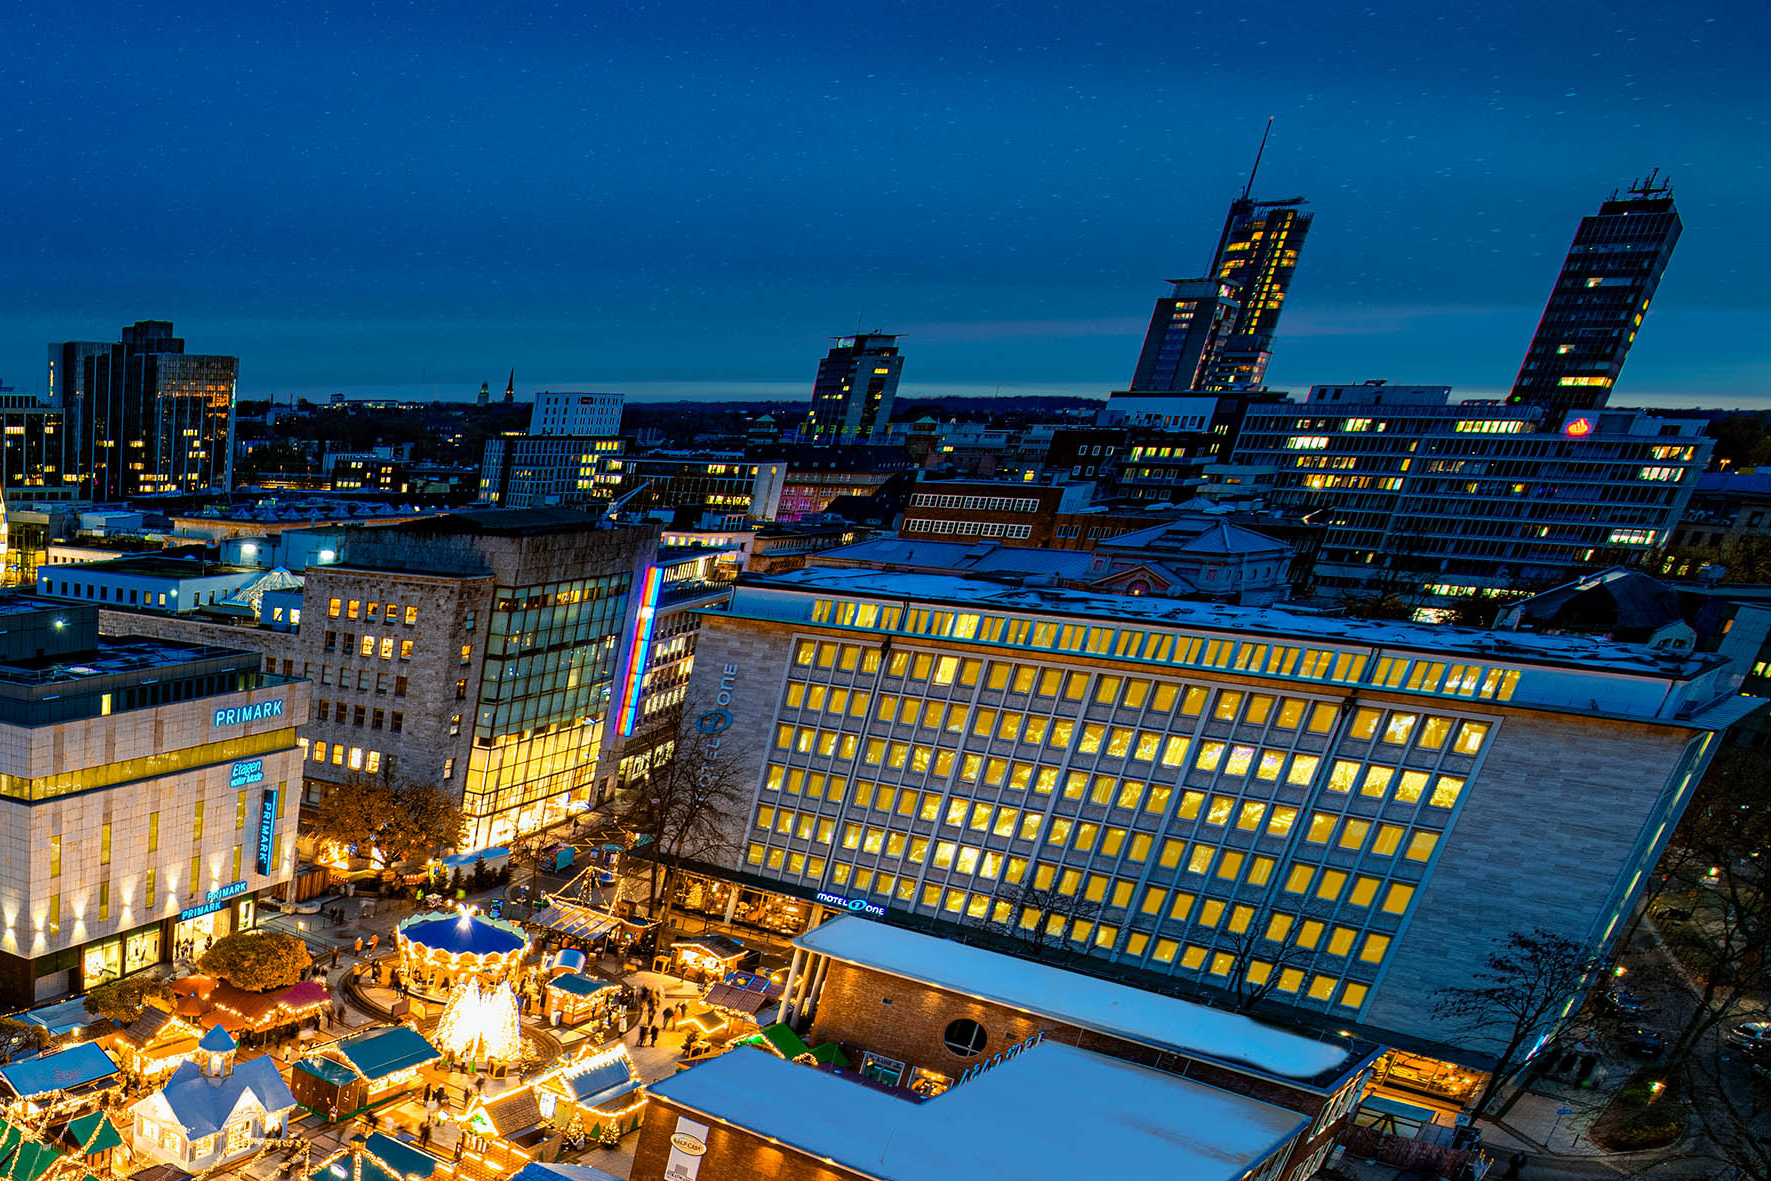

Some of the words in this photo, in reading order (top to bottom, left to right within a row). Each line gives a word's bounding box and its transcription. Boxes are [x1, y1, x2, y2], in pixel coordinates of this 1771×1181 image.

[215, 699, 284, 728] PRIMARK
[232, 761, 262, 777] Etagen
[259, 802, 272, 864] PRIMARK
[206, 882, 246, 901] PRIMARK
[181, 901, 221, 920] PRIMARK
[865, 905, 885, 915] ONE
